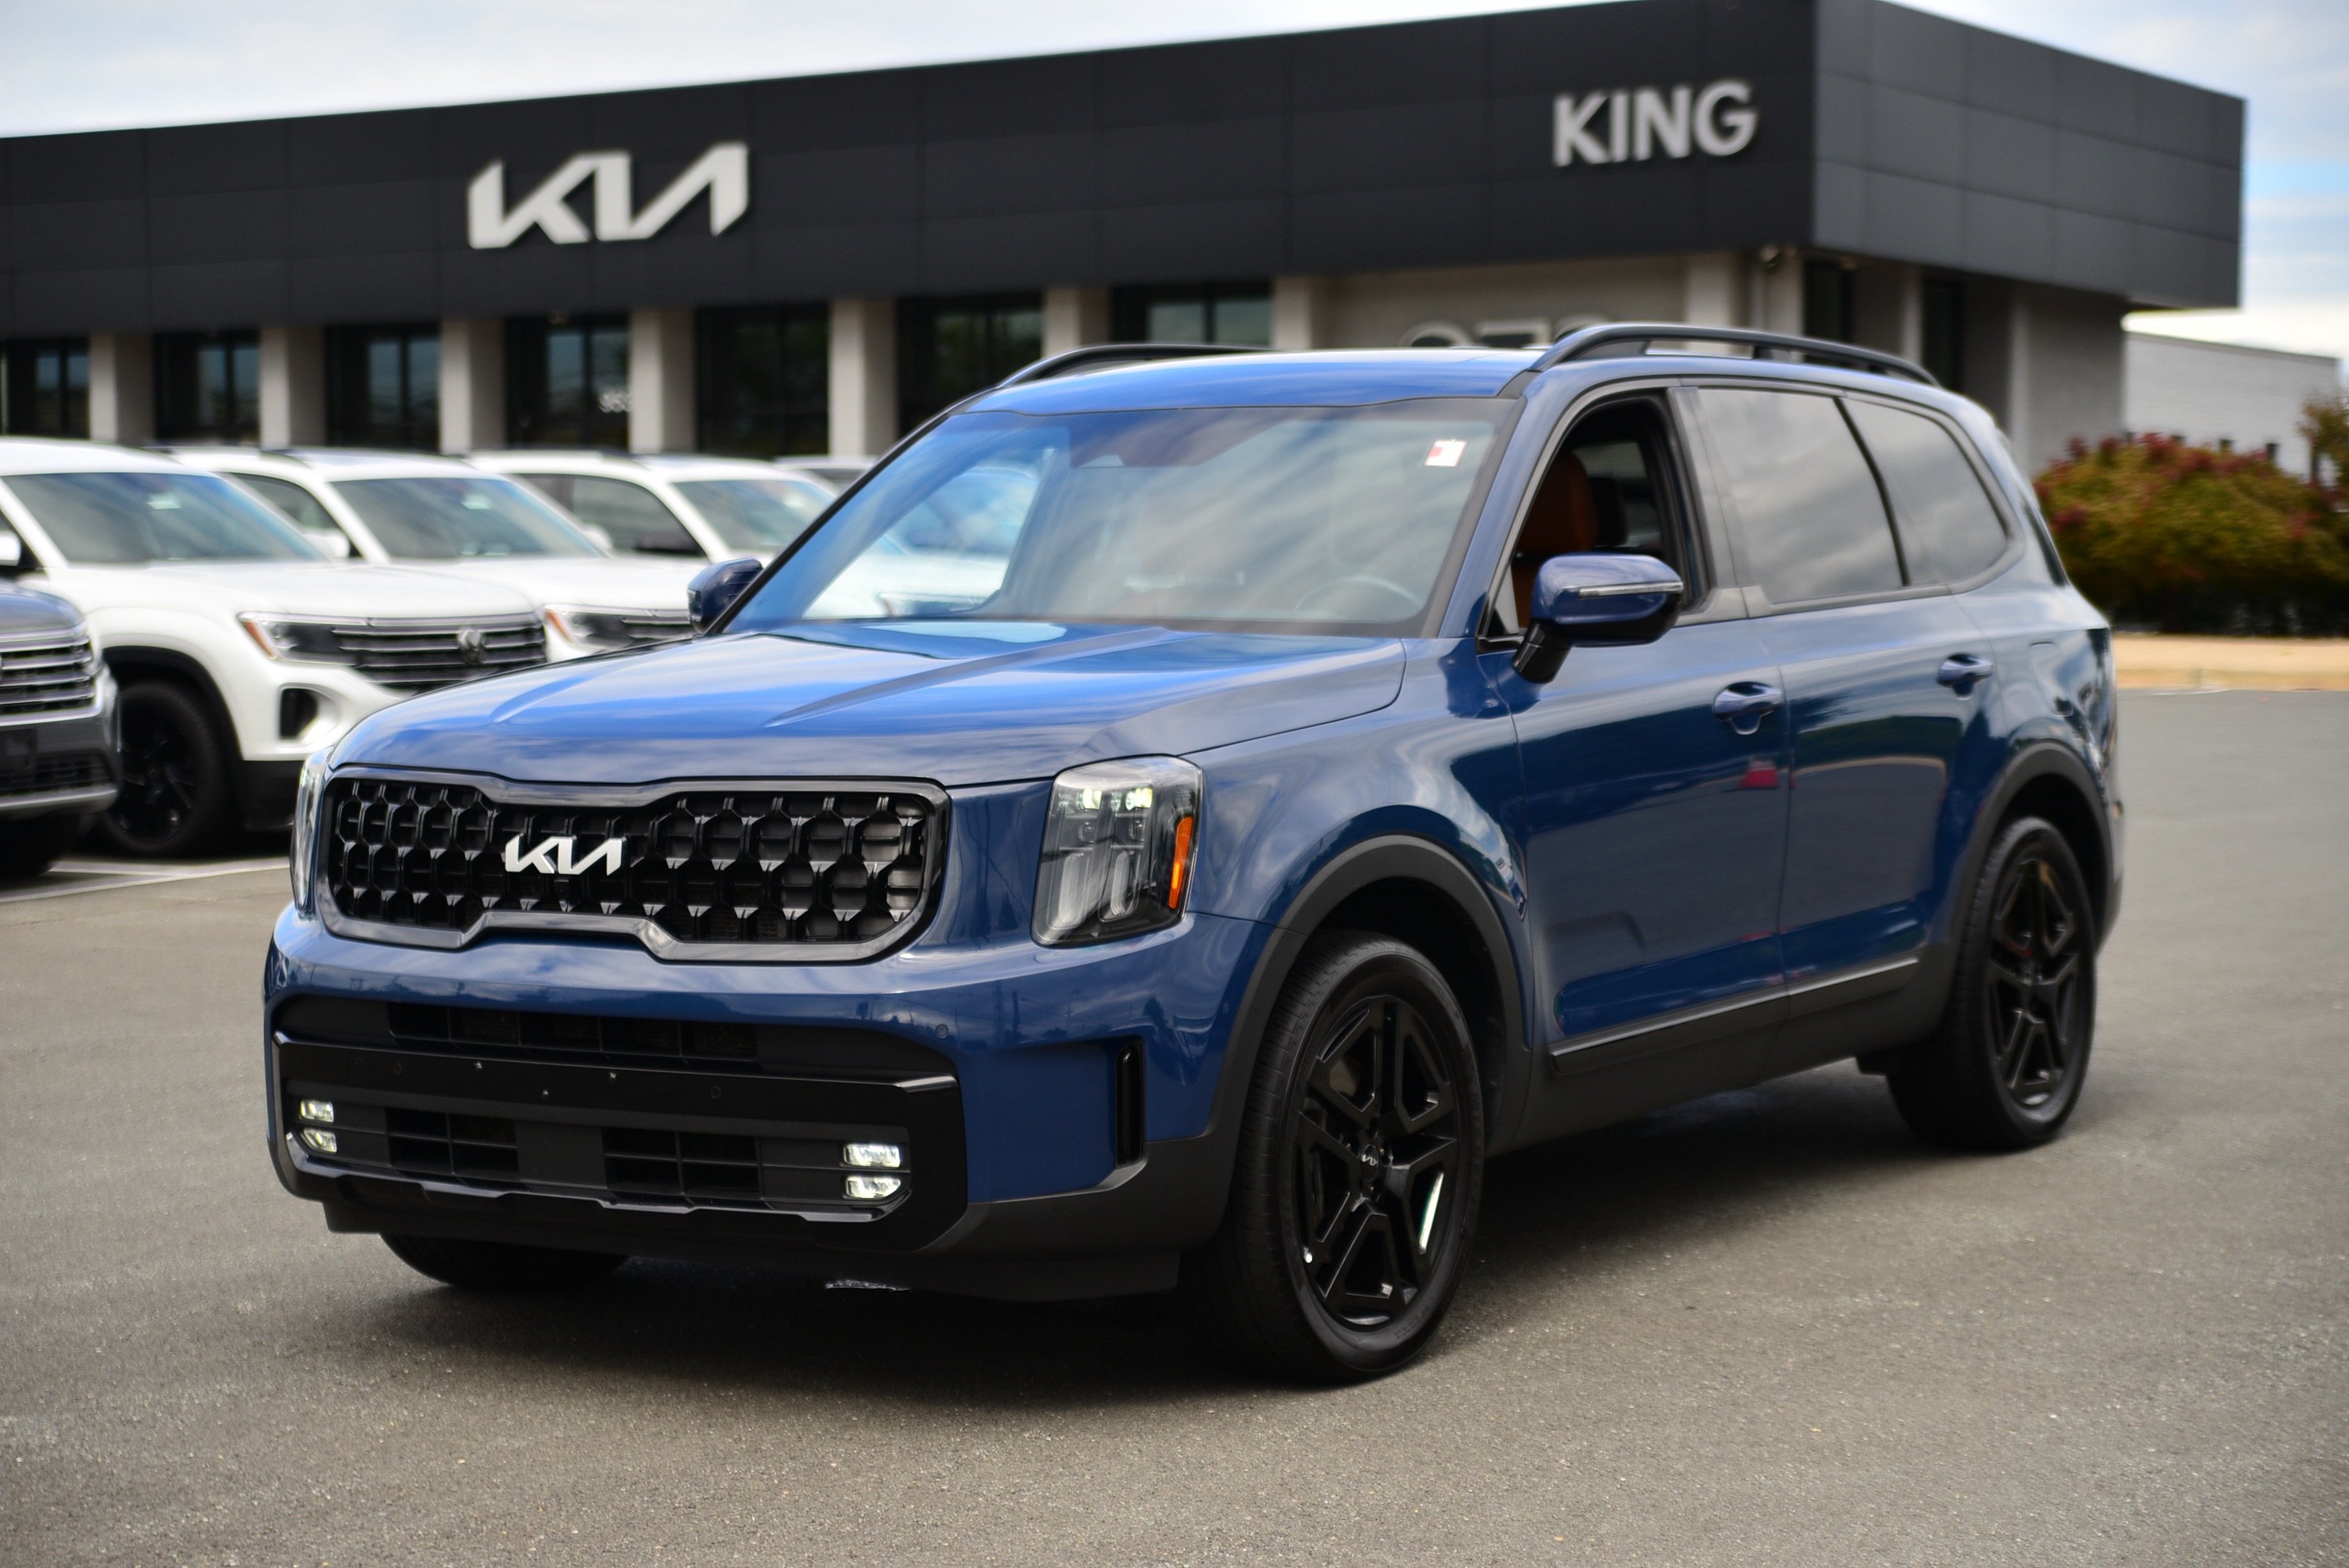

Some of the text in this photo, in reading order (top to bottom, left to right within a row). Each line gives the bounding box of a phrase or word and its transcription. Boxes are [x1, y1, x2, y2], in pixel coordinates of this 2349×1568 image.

[1553, 80, 1757, 166] KING
[468, 143, 749, 249] KIA
[505, 833, 627, 876] KIA
